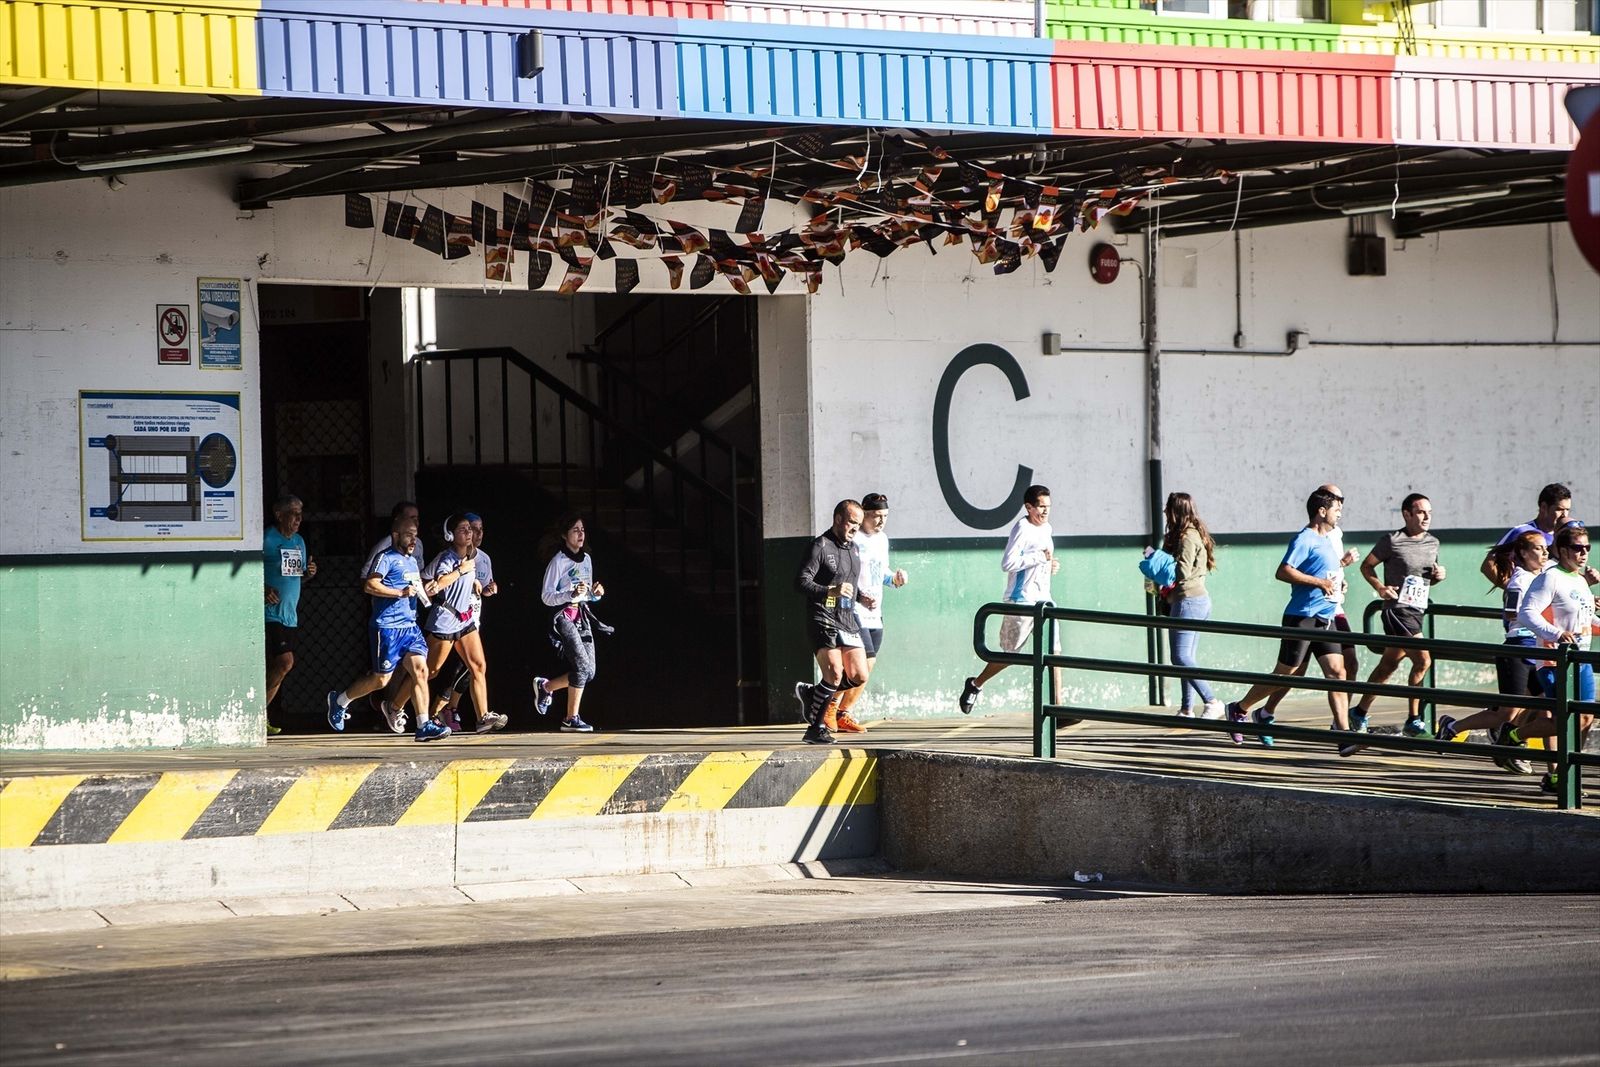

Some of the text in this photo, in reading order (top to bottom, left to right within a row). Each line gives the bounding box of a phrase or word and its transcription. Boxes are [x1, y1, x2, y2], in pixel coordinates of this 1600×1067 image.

[1101, 259, 1118, 267] FUEGO
[933, 343, 1033, 530] C
[283, 558, 302, 568] 1690
